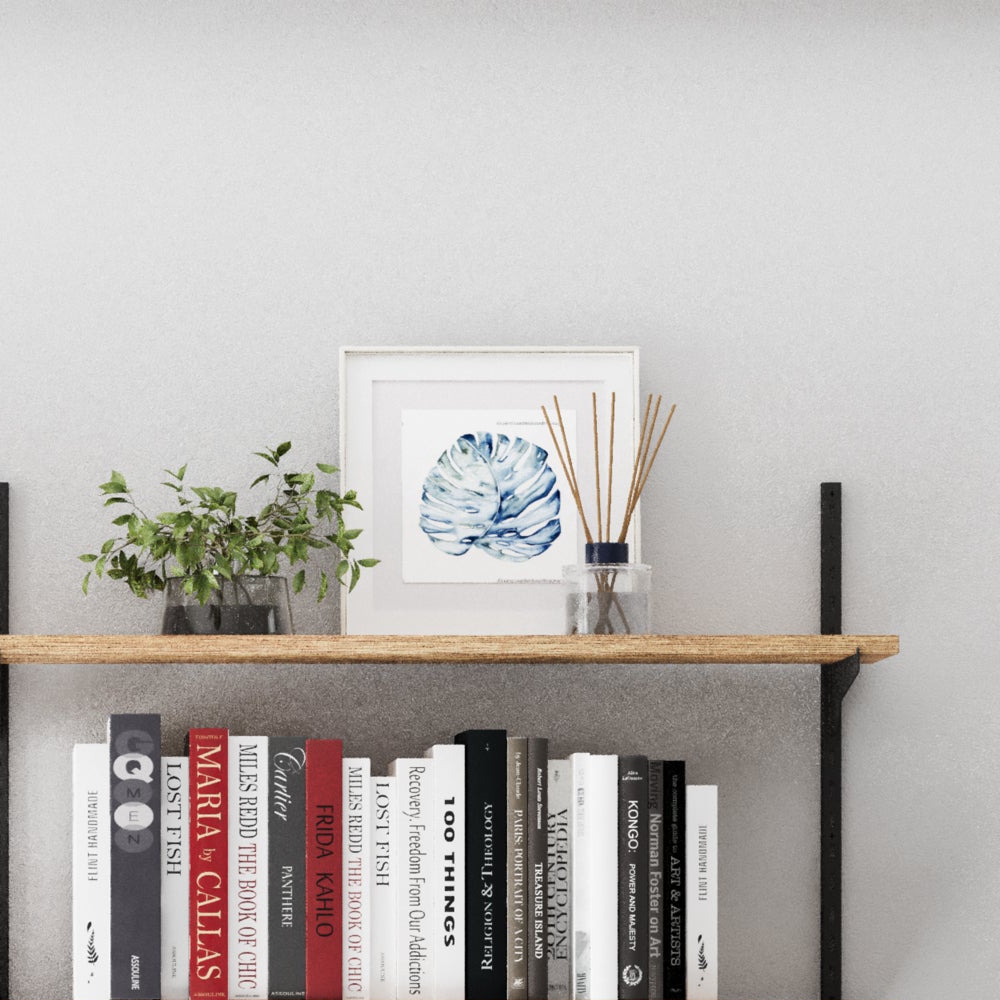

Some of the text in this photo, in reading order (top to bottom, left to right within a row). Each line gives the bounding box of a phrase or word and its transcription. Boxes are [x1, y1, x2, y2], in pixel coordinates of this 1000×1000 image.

[114, 730, 154, 783] GQ
[238, 744, 258, 792] MILES
[670, 775, 678, 787] the
[196, 744, 222, 841] MARIA
[273, 747, 306, 822] Cartier
[87, 791, 98, 881] FLINT HANDMADE
[166, 763, 182, 876] LOST FISH
[238, 797, 258, 839] REDD
[375, 783, 389, 886] LOST FISH
[514, 810, 523, 845] PARIS:
[628, 800, 638, 852] KONGO:
[649, 814, 661, 867] Norman
[199, 848, 216, 862] by
[238, 843, 258, 875] THE
[315, 805, 334, 937] FRIDA KAHLO
[408, 825, 426, 874] Freedom
[444, 797, 455, 947] 100 THINGS
[670, 856, 680, 886] ART
[698, 825, 707, 900] FLINT HANDMADE
[238, 880, 258, 921] BOOK
[281, 865, 293, 927] PANTHERE
[348, 766, 362, 992] MILES REDD THE BOOK OF CHIC
[408, 877, 426, 907] From
[514, 848, 523, 906] PORTRAIT
[556, 809, 568, 960] ENCYCLOPEDIA
[649, 871, 661, 914] Foster
[670, 890, 680, 901] &
[196, 871, 222, 981] CALLAS
[408, 910, 426, 933] Our
[514, 909, 523, 924] OF
[535, 862, 543, 959] TREASURE ISLAND
[628, 863, 636, 951] POWER AND MAJESTY
[649, 918, 659, 933] on
[238, 927, 258, 947] OF
[514, 937, 523, 962] CITY
[649, 937, 661, 958] Art
[670, 904, 680, 966] ARTISTS
[131, 955, 140, 990] ASSOULINE
[238, 952, 258, 989] CHIC
[408, 935, 426, 995] Addictions
